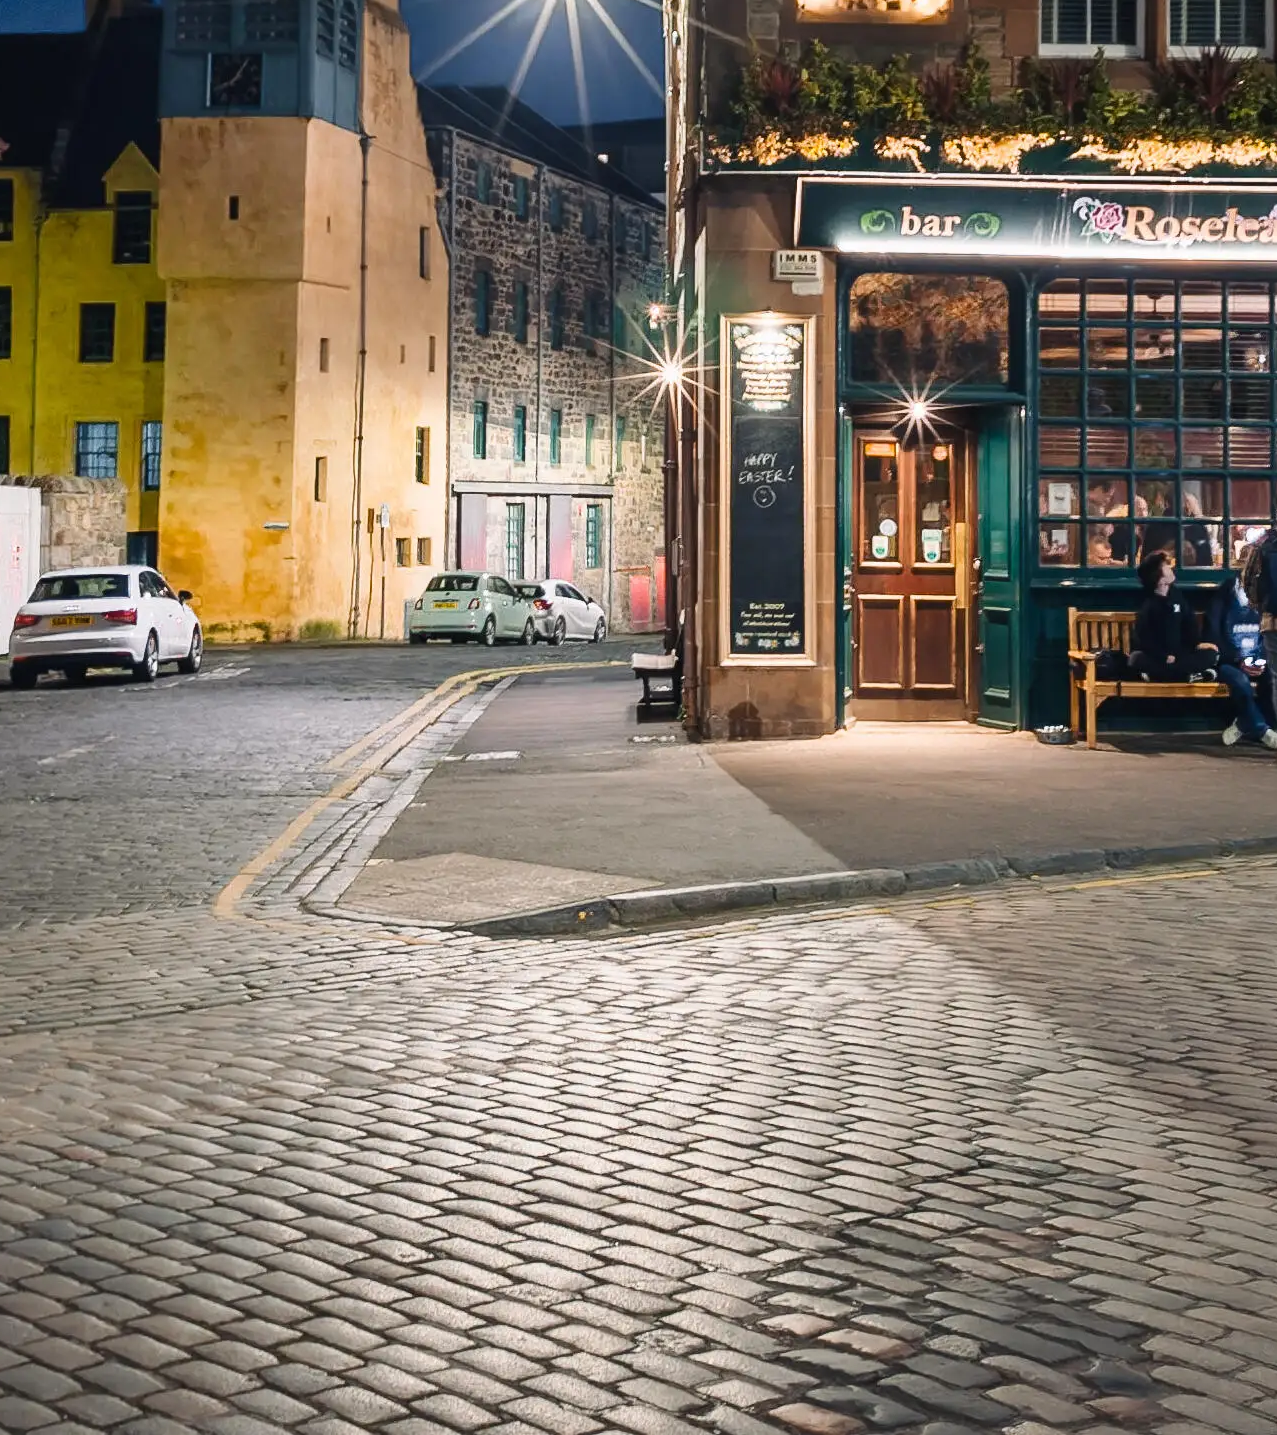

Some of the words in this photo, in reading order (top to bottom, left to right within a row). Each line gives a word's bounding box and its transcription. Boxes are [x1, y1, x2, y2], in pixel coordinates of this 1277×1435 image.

[900, 205, 961, 237] bar
[743, 453, 778, 468] HAPPY
[738, 465, 795, 484] EASTER!
